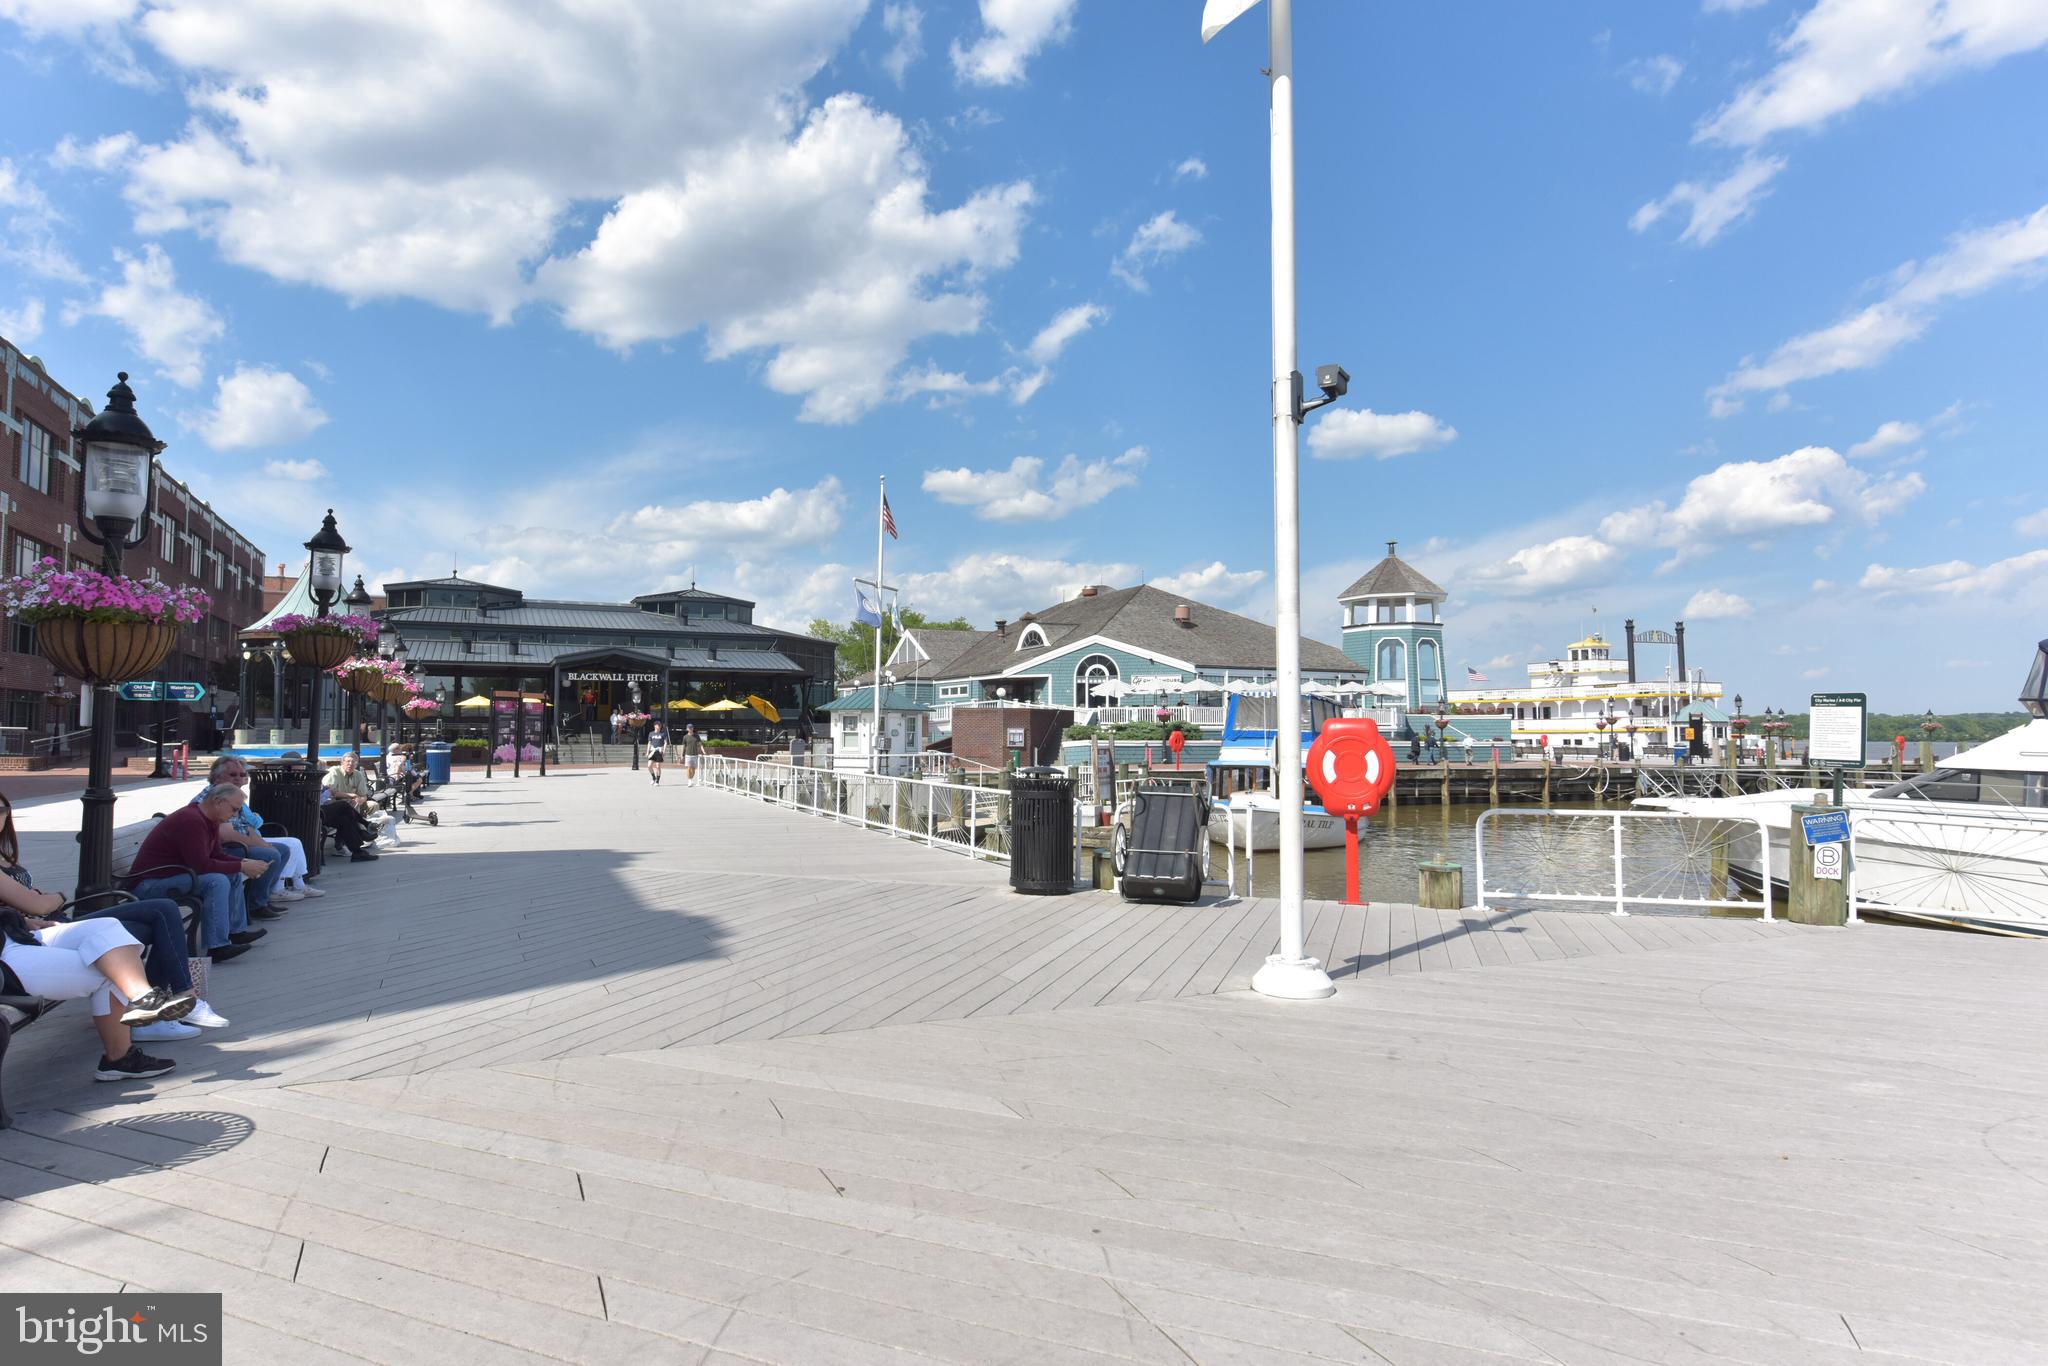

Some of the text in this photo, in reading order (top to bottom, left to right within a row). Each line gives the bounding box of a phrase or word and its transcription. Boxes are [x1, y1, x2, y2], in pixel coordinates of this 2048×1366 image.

[568, 672, 658, 681] BLACKWALL HITCH
[1805, 814, 1844, 825] WARNING
[1823, 849, 1835, 863] B
[1816, 866, 1839, 875] DOCK
